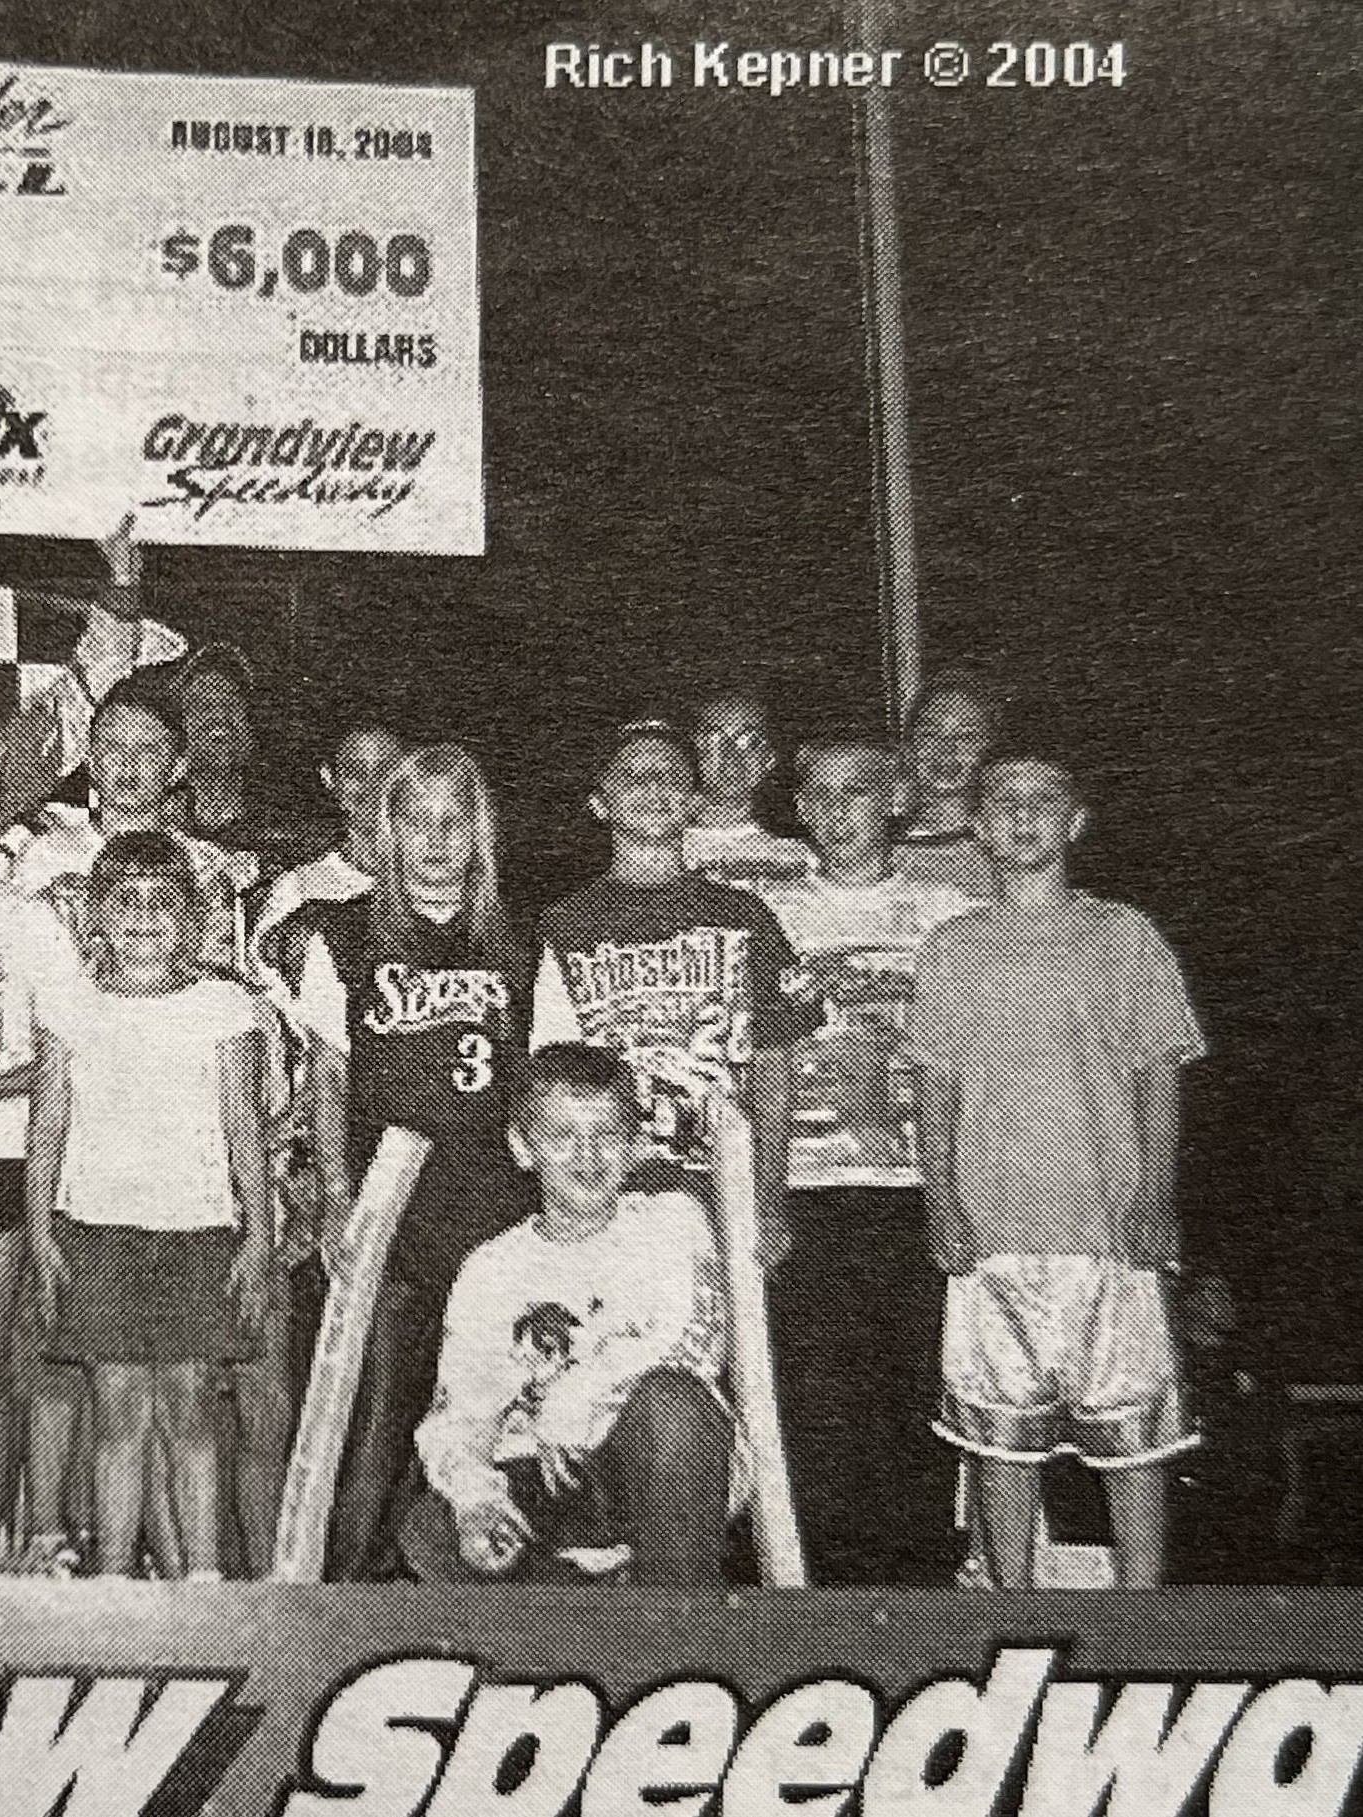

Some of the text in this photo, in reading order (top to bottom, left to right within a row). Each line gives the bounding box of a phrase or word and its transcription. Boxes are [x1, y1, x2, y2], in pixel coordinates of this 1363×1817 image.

[171, 120, 290, 156] AUGUST
[159, 224, 432, 298] $6,000
[299, 329, 437, 369] DOLLARS
[143, 412, 436, 473] Grandview
[139, 462, 416, 521] Speedway
[451, 1032, 494, 1094] 3
